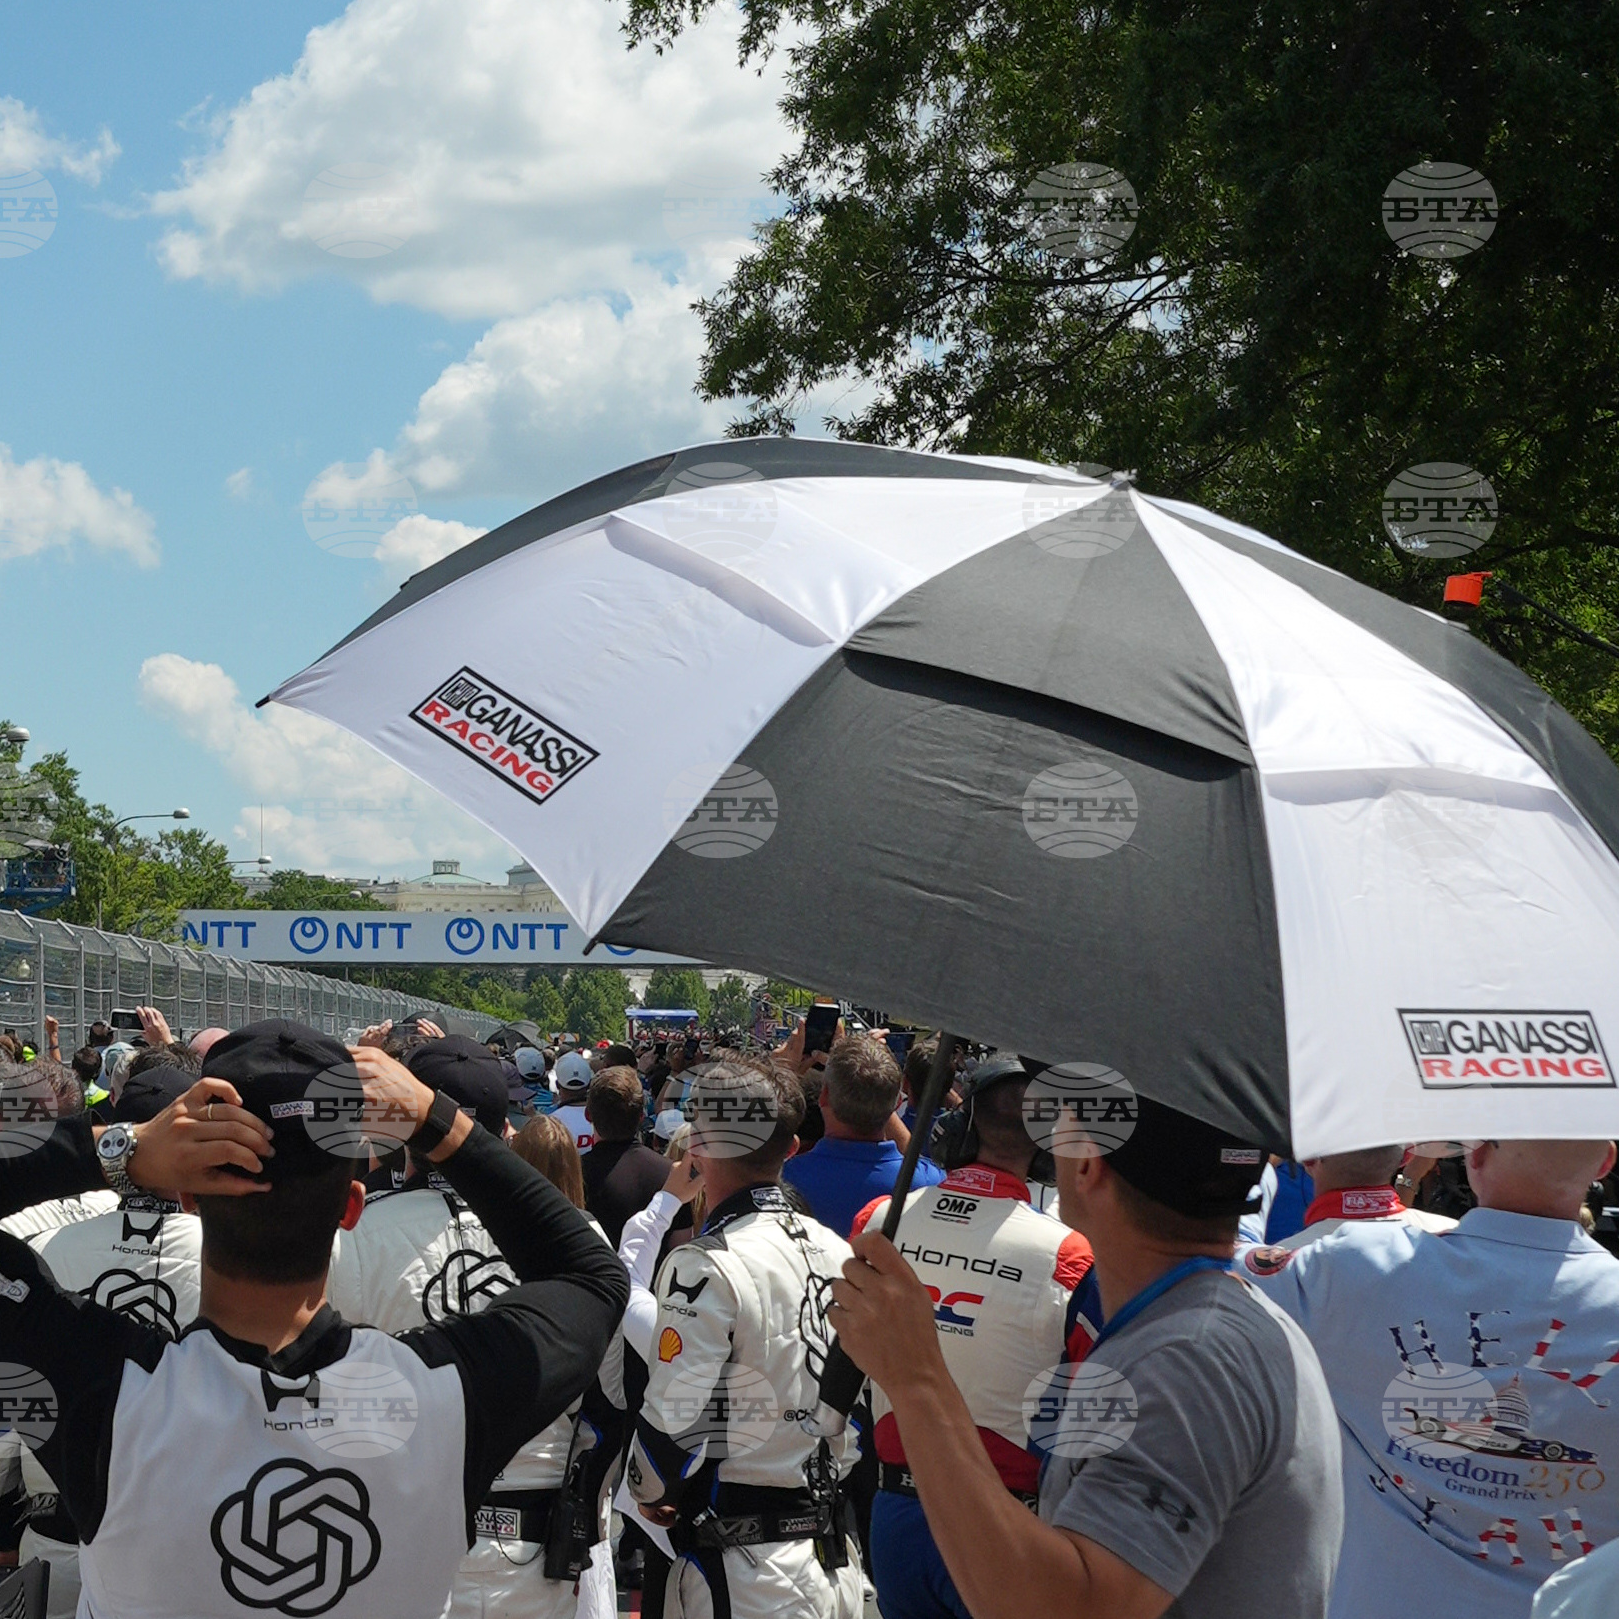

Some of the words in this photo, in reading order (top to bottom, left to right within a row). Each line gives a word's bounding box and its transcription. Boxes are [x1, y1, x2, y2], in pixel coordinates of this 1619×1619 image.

[421, 699, 554, 794] RACING
[465, 693, 585, 779] GANASSI
[183, 921, 257, 948] NTT
[336, 922, 412, 950] NTT
[492, 922, 569, 951] NTT
[1447, 1020, 1598, 1055] GANASSI
[1421, 1058, 1606, 1078] RACING
[936, 1197, 978, 1215] OMP
[111, 1244, 160, 1256] Honda
[900, 1242, 1023, 1283] Honda
[263, 1417, 334, 1431] Honda
[1385, 1435, 1520, 1487] Freedom
[1444, 1478, 1499, 1499] Grand
[1502, 1488, 1538, 1501] Prix
